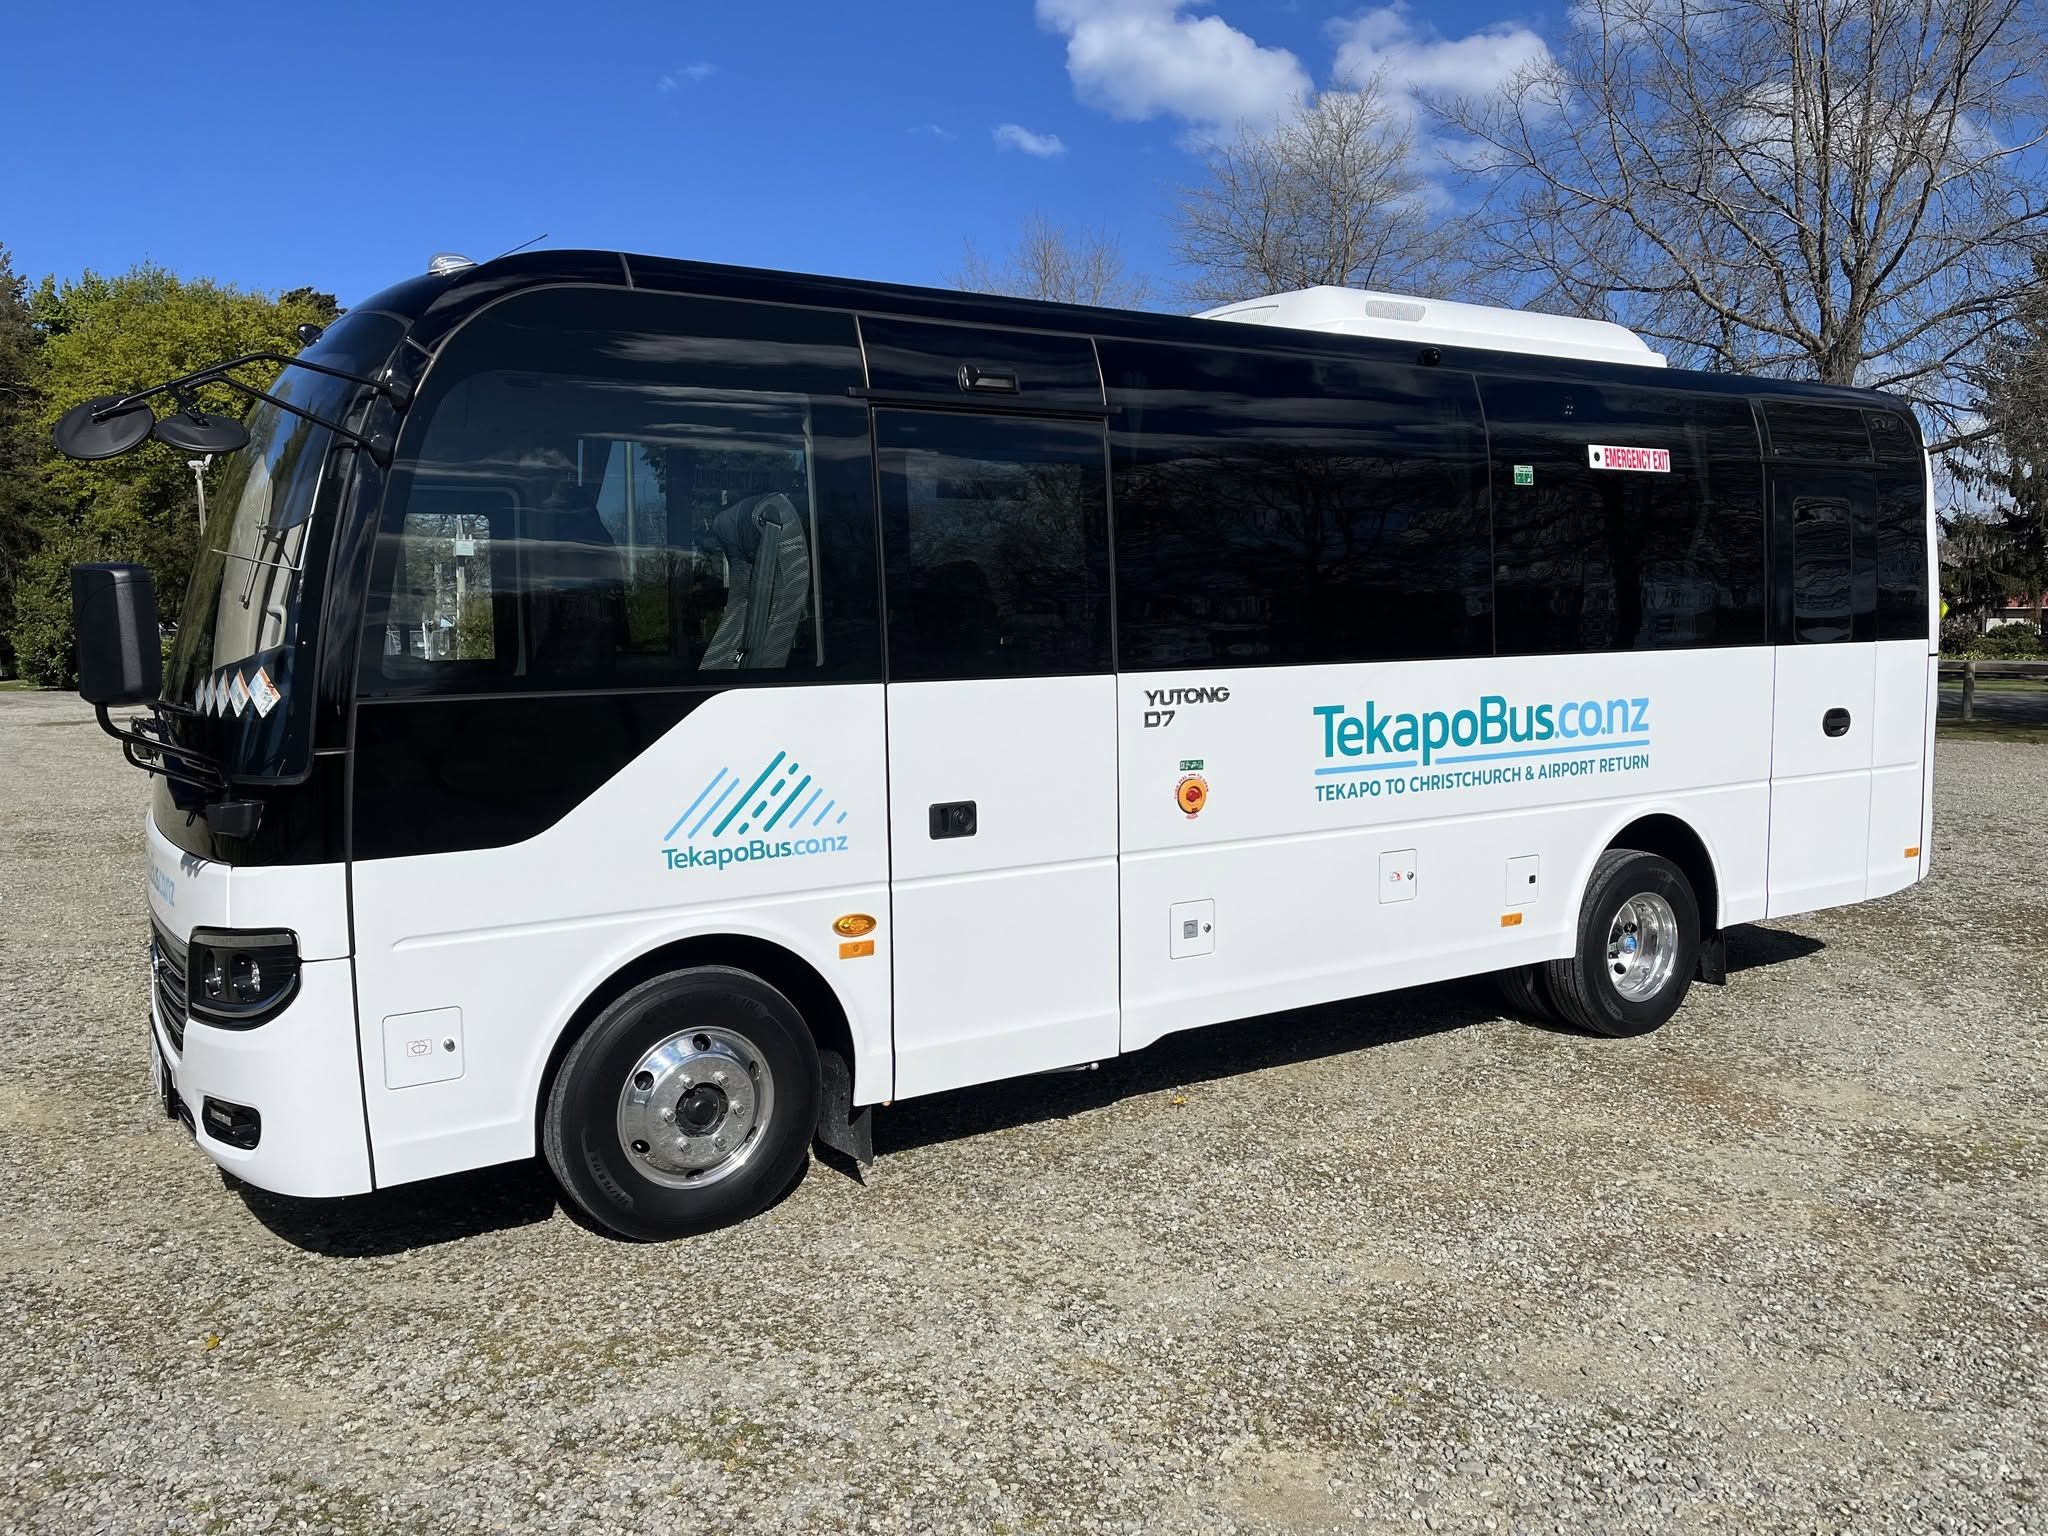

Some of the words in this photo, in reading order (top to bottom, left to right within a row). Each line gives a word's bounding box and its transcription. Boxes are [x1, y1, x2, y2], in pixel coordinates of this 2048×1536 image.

[1604, 448, 1650, 469] EMERGENCY
[1652, 451, 1669, 470] EXIT
[1144, 686, 1231, 707] YUTONG
[1144, 710, 1176, 728] D7
[1313, 695, 1649, 766] TekapoBus.co.nz
[1315, 780, 1381, 802] TEKAPO
[1385, 778, 1405, 795] TO
[1410, 766, 1521, 793] CHRISTCHURCH
[1525, 765, 1534, 781] &
[1538, 759, 1596, 780] AIRPORT
[1599, 754, 1649, 773] RETURN
[661, 835, 849, 871] TekapoBus.co.nz
